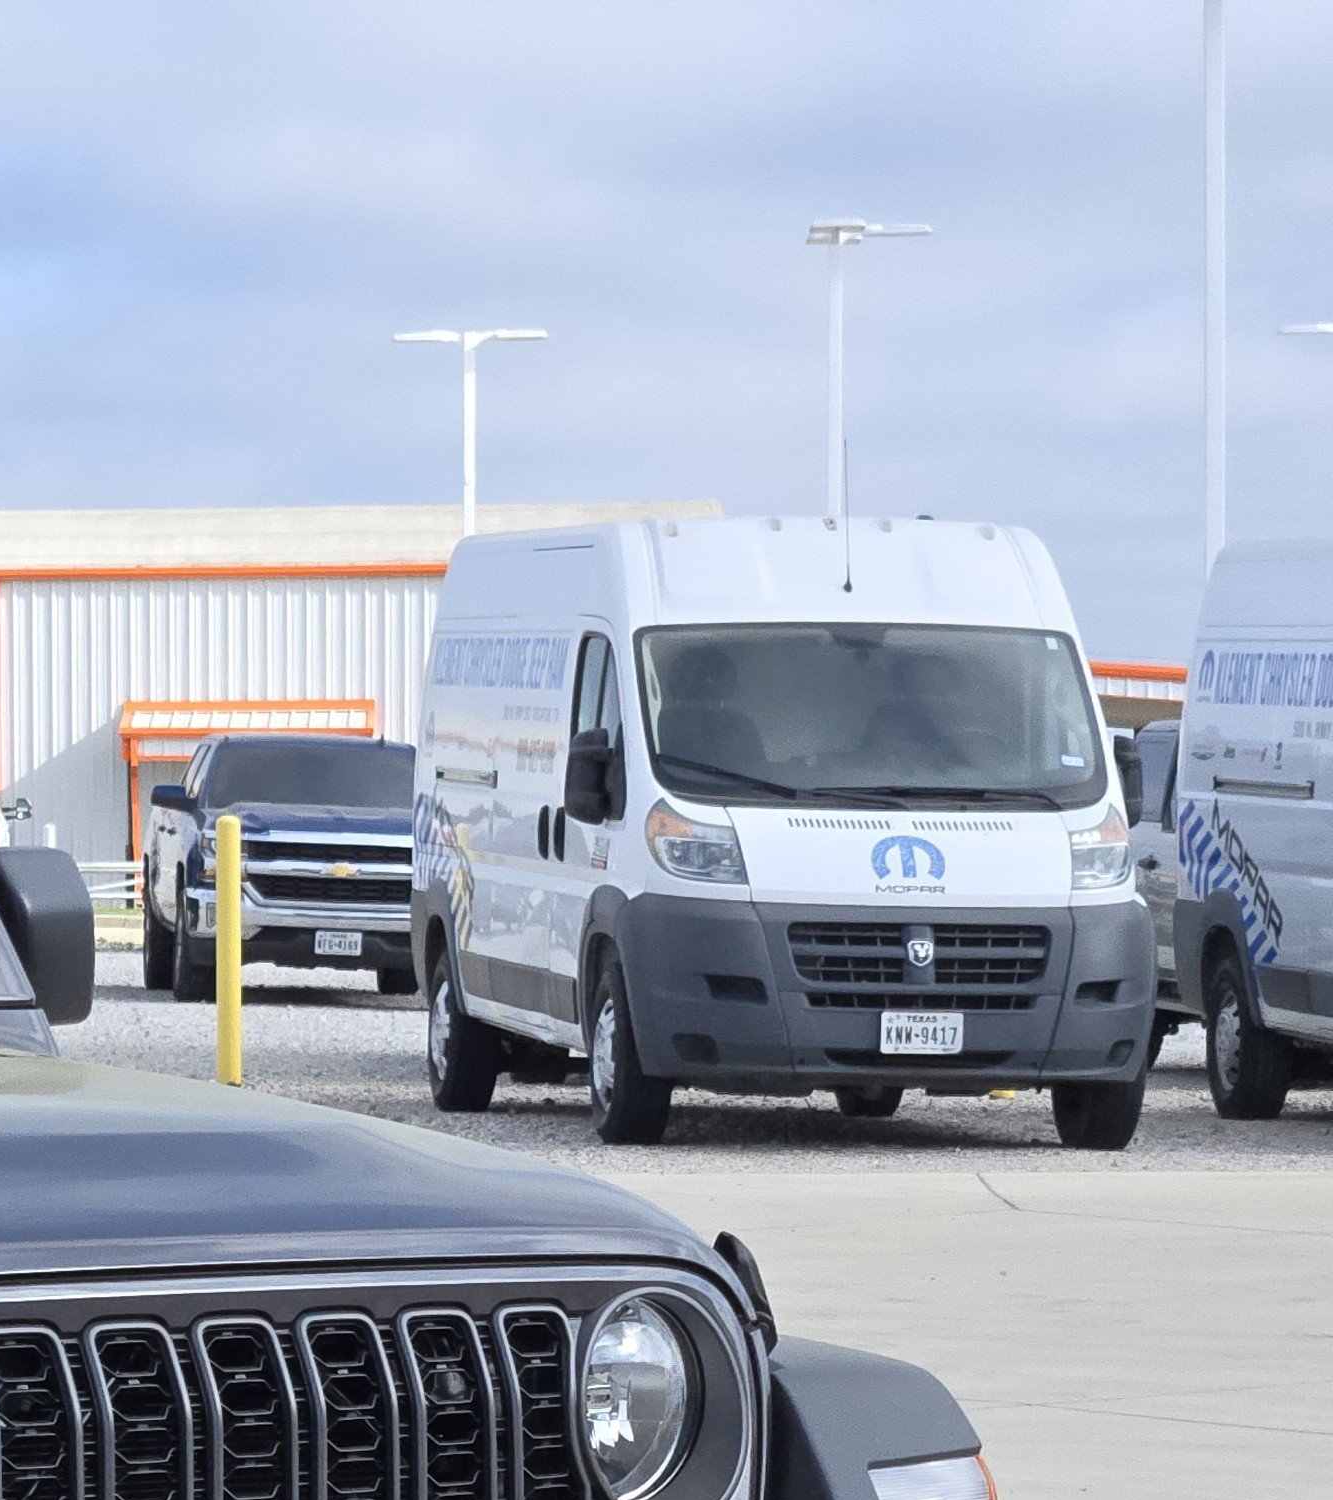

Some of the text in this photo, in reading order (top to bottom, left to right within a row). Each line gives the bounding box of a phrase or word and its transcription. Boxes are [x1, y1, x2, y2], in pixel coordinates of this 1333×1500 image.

[1211, 797, 1283, 947] MOPAR
[875, 885, 946, 894] MOPAR
[906, 1015, 938, 1023] TEXAS
